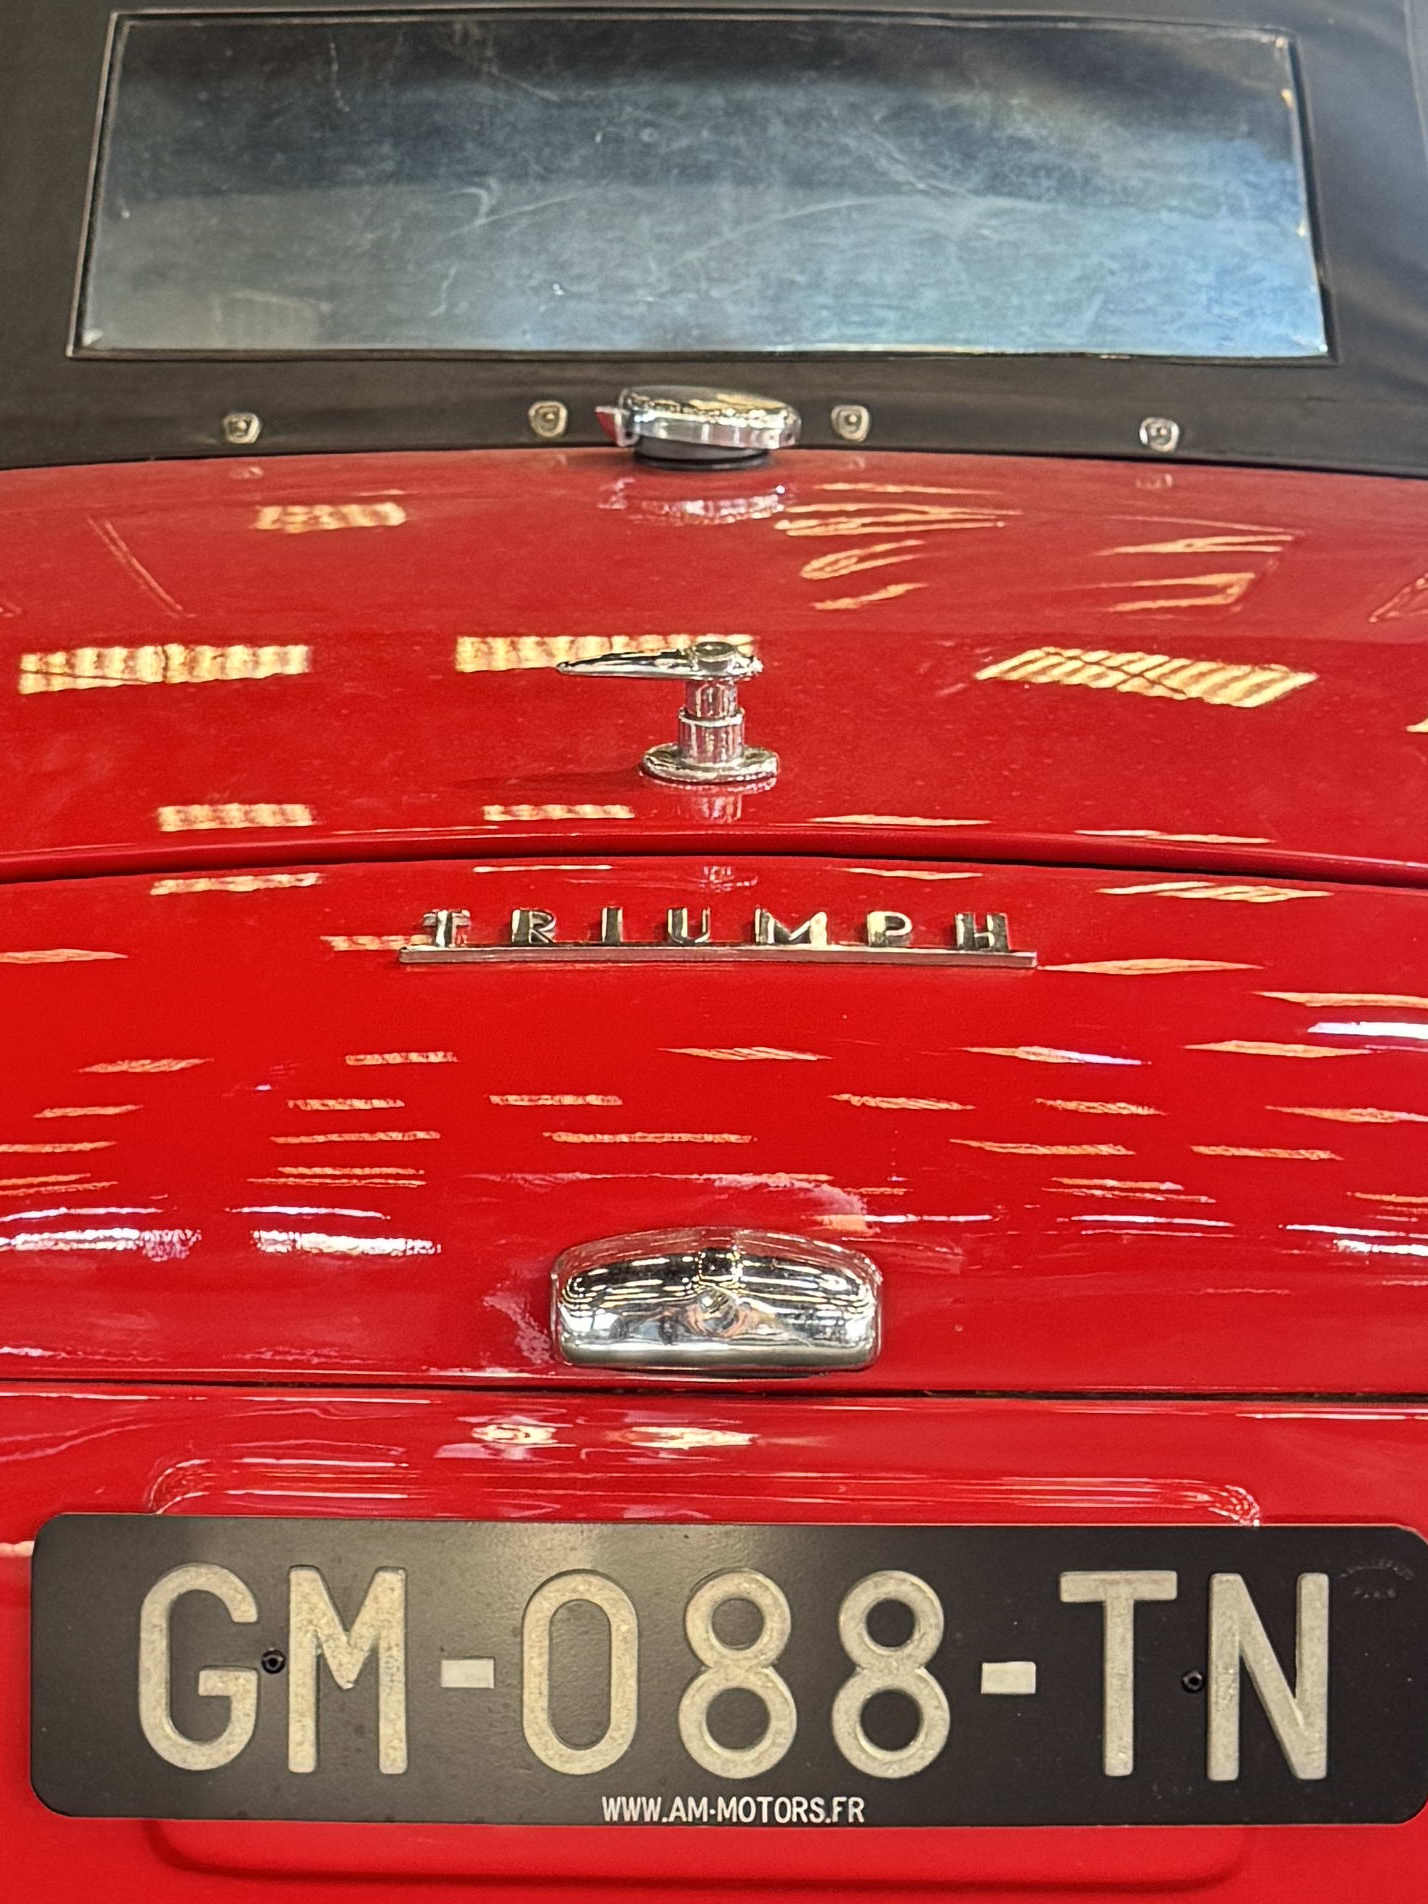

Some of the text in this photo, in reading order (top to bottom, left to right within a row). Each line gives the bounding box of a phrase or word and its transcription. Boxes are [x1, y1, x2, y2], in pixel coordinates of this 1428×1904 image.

[422, 905, 1011, 953] TRIUMPH
[137, 1562, 1330, 1781] GM-088-TN
[601, 1796, 866, 1824] WWW.AM-MOTORS.FR
